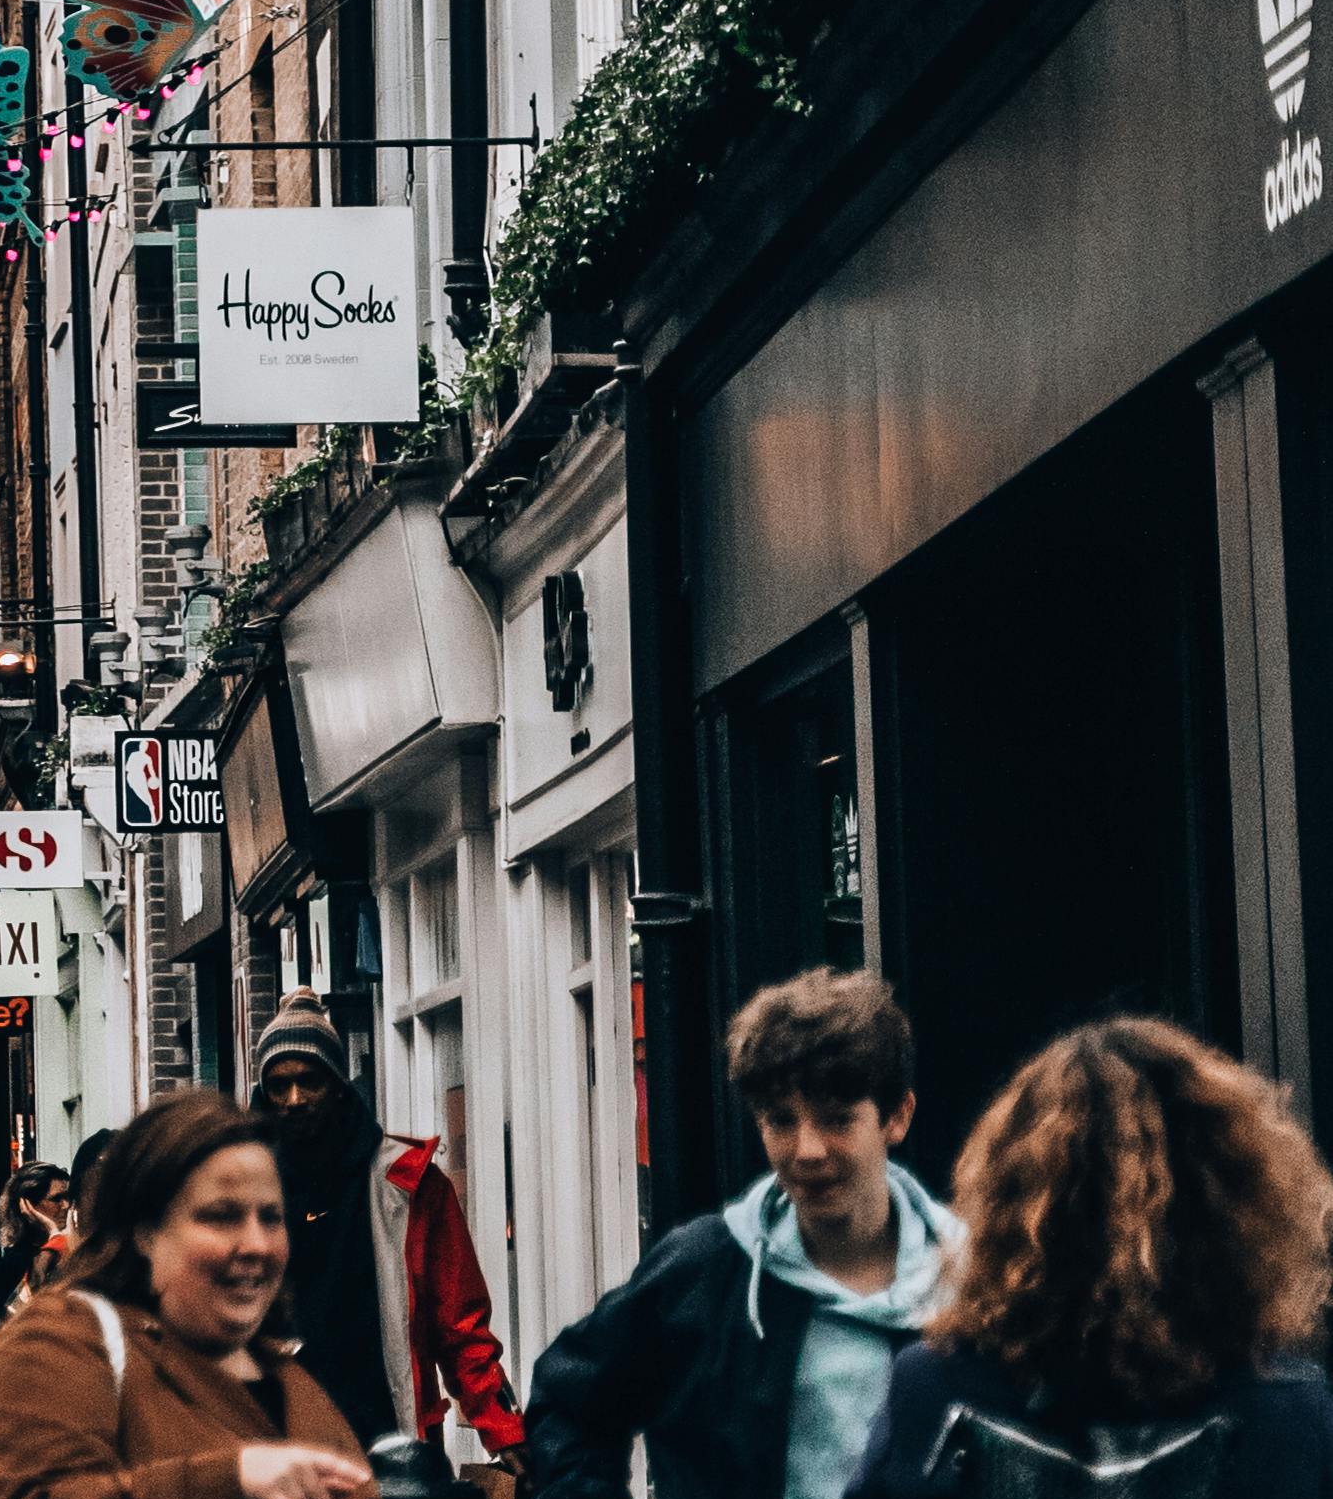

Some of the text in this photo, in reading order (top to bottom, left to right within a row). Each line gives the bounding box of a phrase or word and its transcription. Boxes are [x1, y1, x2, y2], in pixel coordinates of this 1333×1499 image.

[1265, 130, 1323, 232] adidas
[217, 269, 396, 342] Happy Socks
[285, 354, 312, 365] 2008
[314, 353, 359, 365] Sweden
[168, 739, 218, 781] NBA
[169, 782, 225, 824] Store
